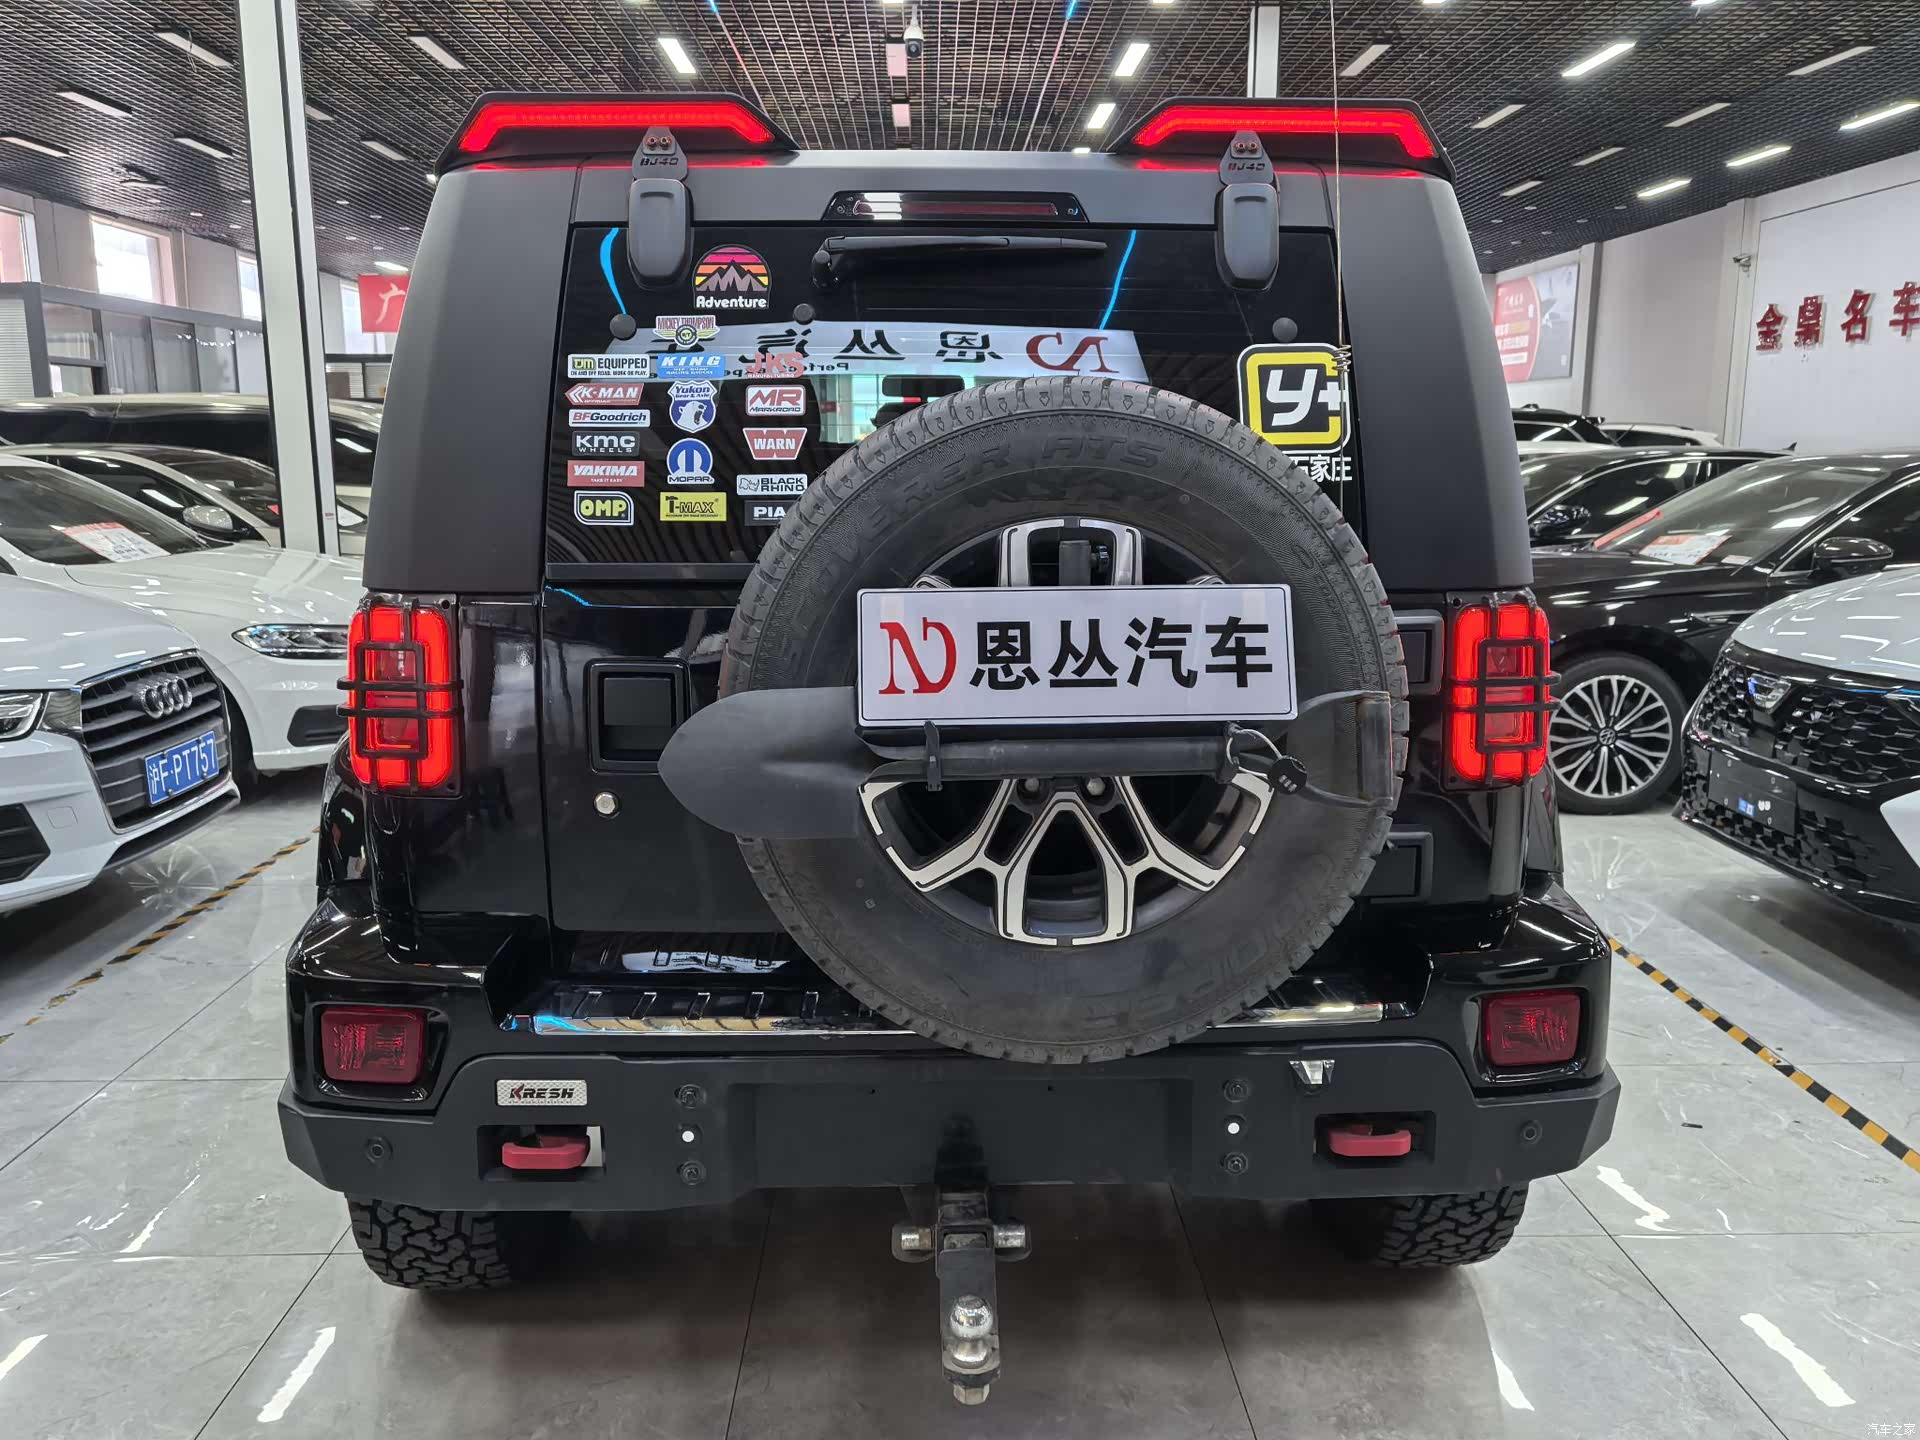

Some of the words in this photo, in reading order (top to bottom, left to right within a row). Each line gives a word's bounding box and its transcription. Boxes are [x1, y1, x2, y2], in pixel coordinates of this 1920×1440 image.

[696, 295, 767, 308] Adventure
[597, 358, 647, 369] EQUIPPED
[662, 356, 721, 366] KING
[746, 352, 804, 378] JKS
[581, 387, 638, 399] K-MAN
[675, 385, 710, 394] Yukon
[573, 411, 647, 421] BFGoodrich
[754, 438, 796, 450] WARN
[573, 465, 638, 476] YAKIMA
[580, 499, 627, 516] OMP
[969, 616, 1273, 690] 恩丛汽车
[509, 1083, 575, 1101] KRESH
